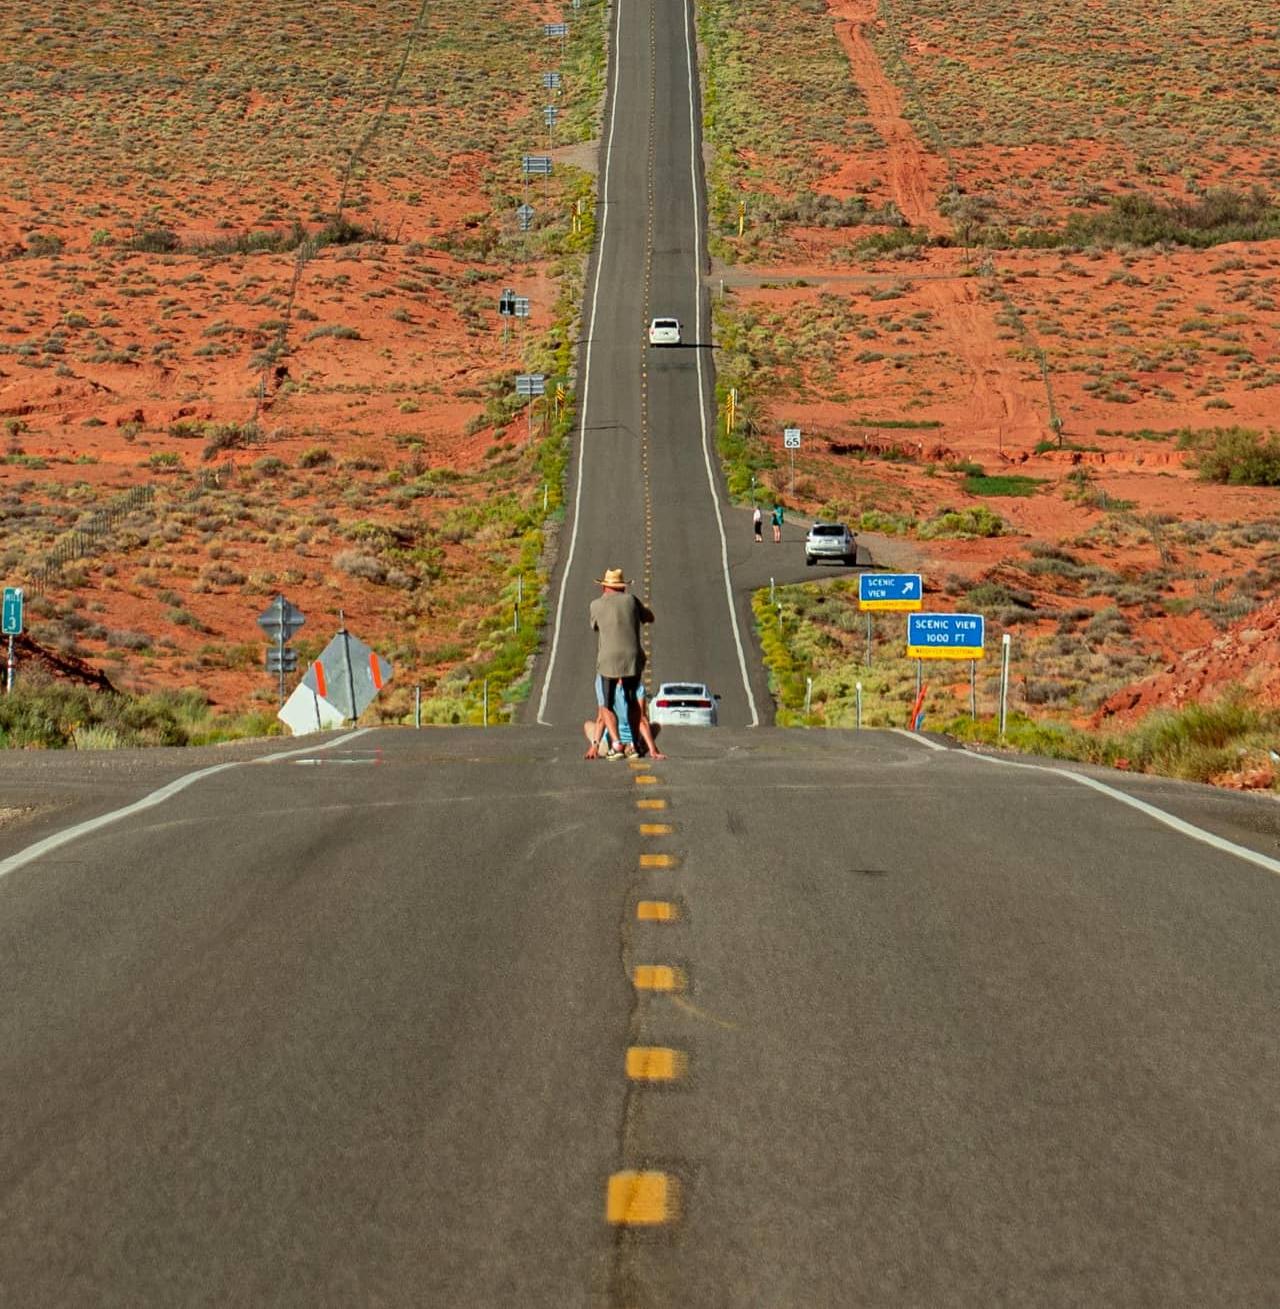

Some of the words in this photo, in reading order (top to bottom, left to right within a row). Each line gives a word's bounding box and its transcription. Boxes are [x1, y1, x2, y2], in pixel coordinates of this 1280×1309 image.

[786, 437, 799, 447] 65
[868, 578, 895, 587] SCENIC
[915, 619, 949, 629] SCENIC
[955, 620, 976, 629] VIEW
[926, 633, 949, 643] 1000
[954, 633, 965, 643] FT
